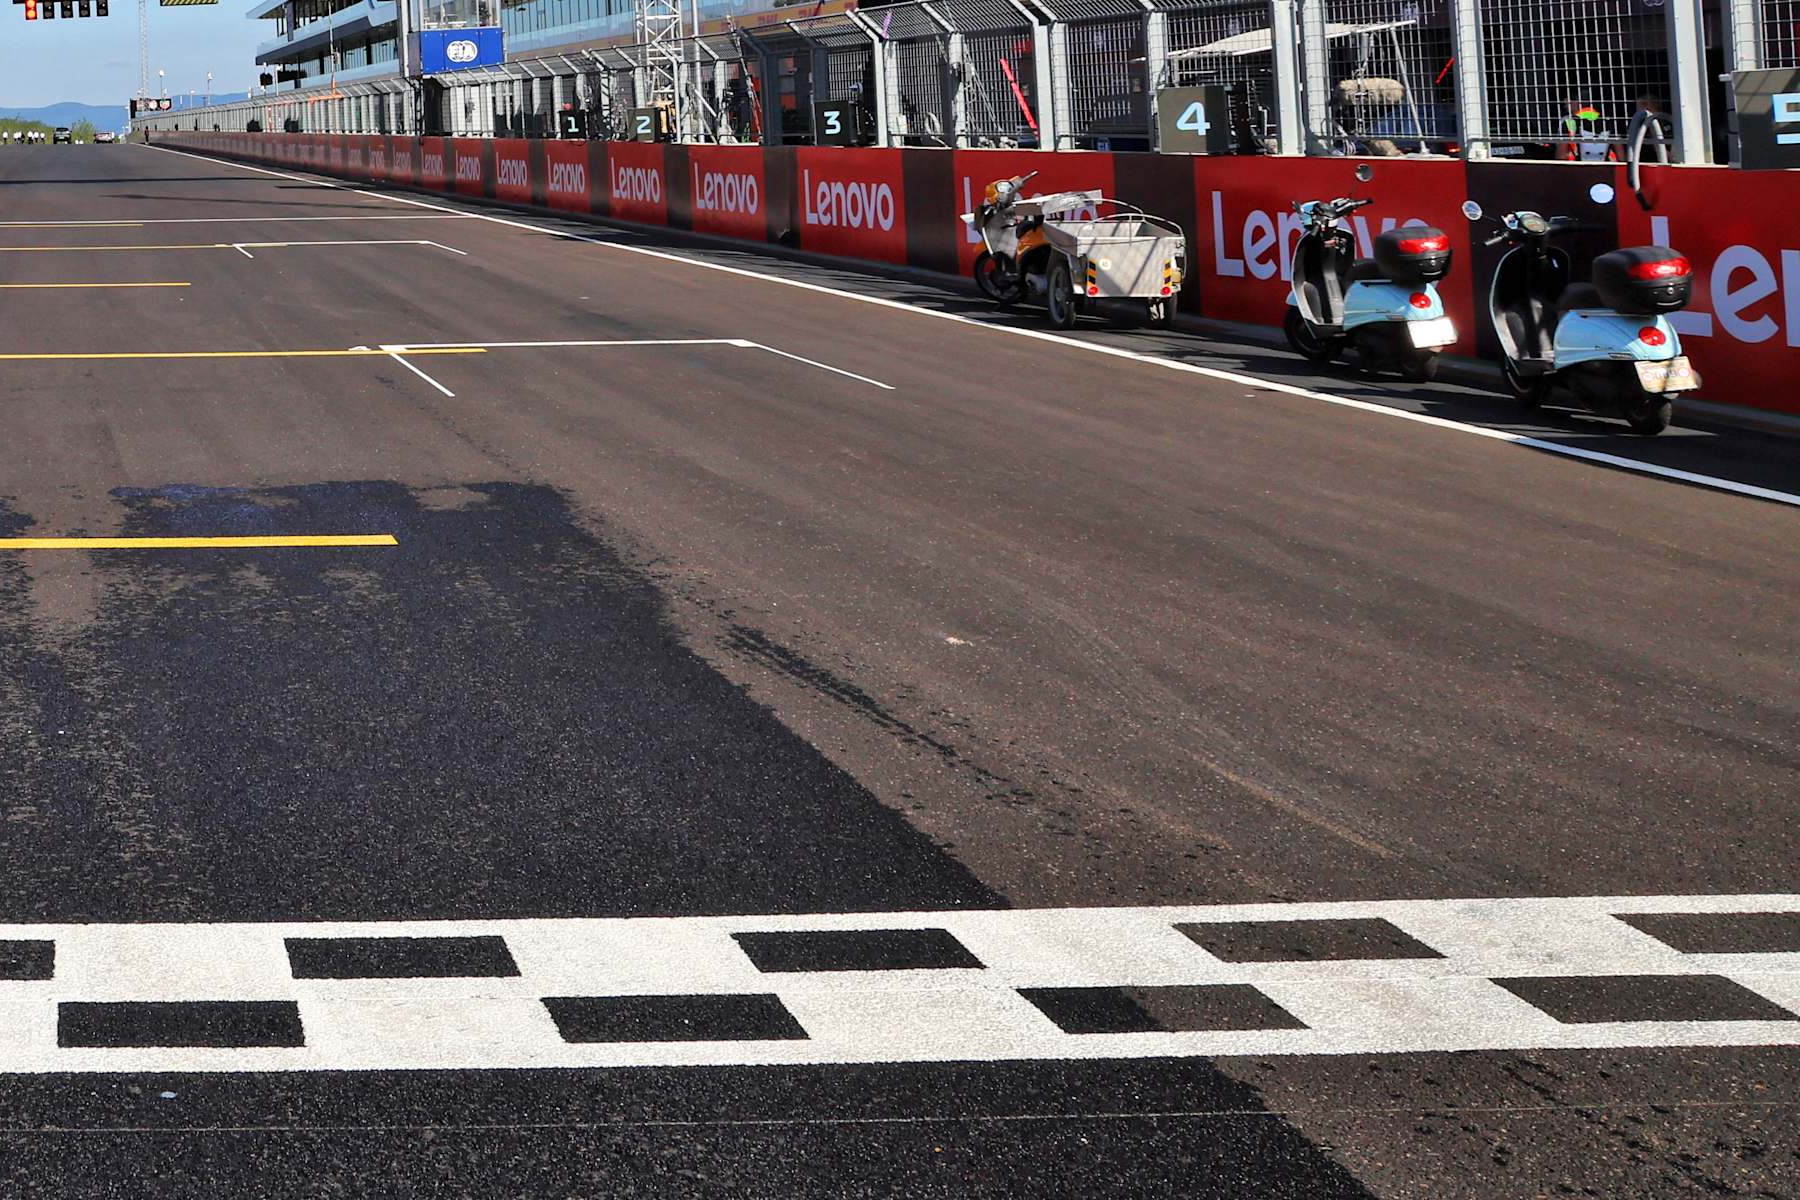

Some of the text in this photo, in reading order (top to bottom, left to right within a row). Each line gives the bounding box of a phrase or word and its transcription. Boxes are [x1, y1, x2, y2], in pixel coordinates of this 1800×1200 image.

[567, 116, 579, 133] 1
[636, 115, 651, 134] 2
[823, 110, 842, 135] 3
[1175, 101, 1211, 136] 4
[456, 150, 481, 181] Lenovo
[496, 152, 528, 187] Lenovo
[547, 154, 586, 194] Lenovo
[610, 157, 661, 205] Lenovo
[694, 162, 759, 215] Lenovo
[803, 168, 895, 232] Lenovo
